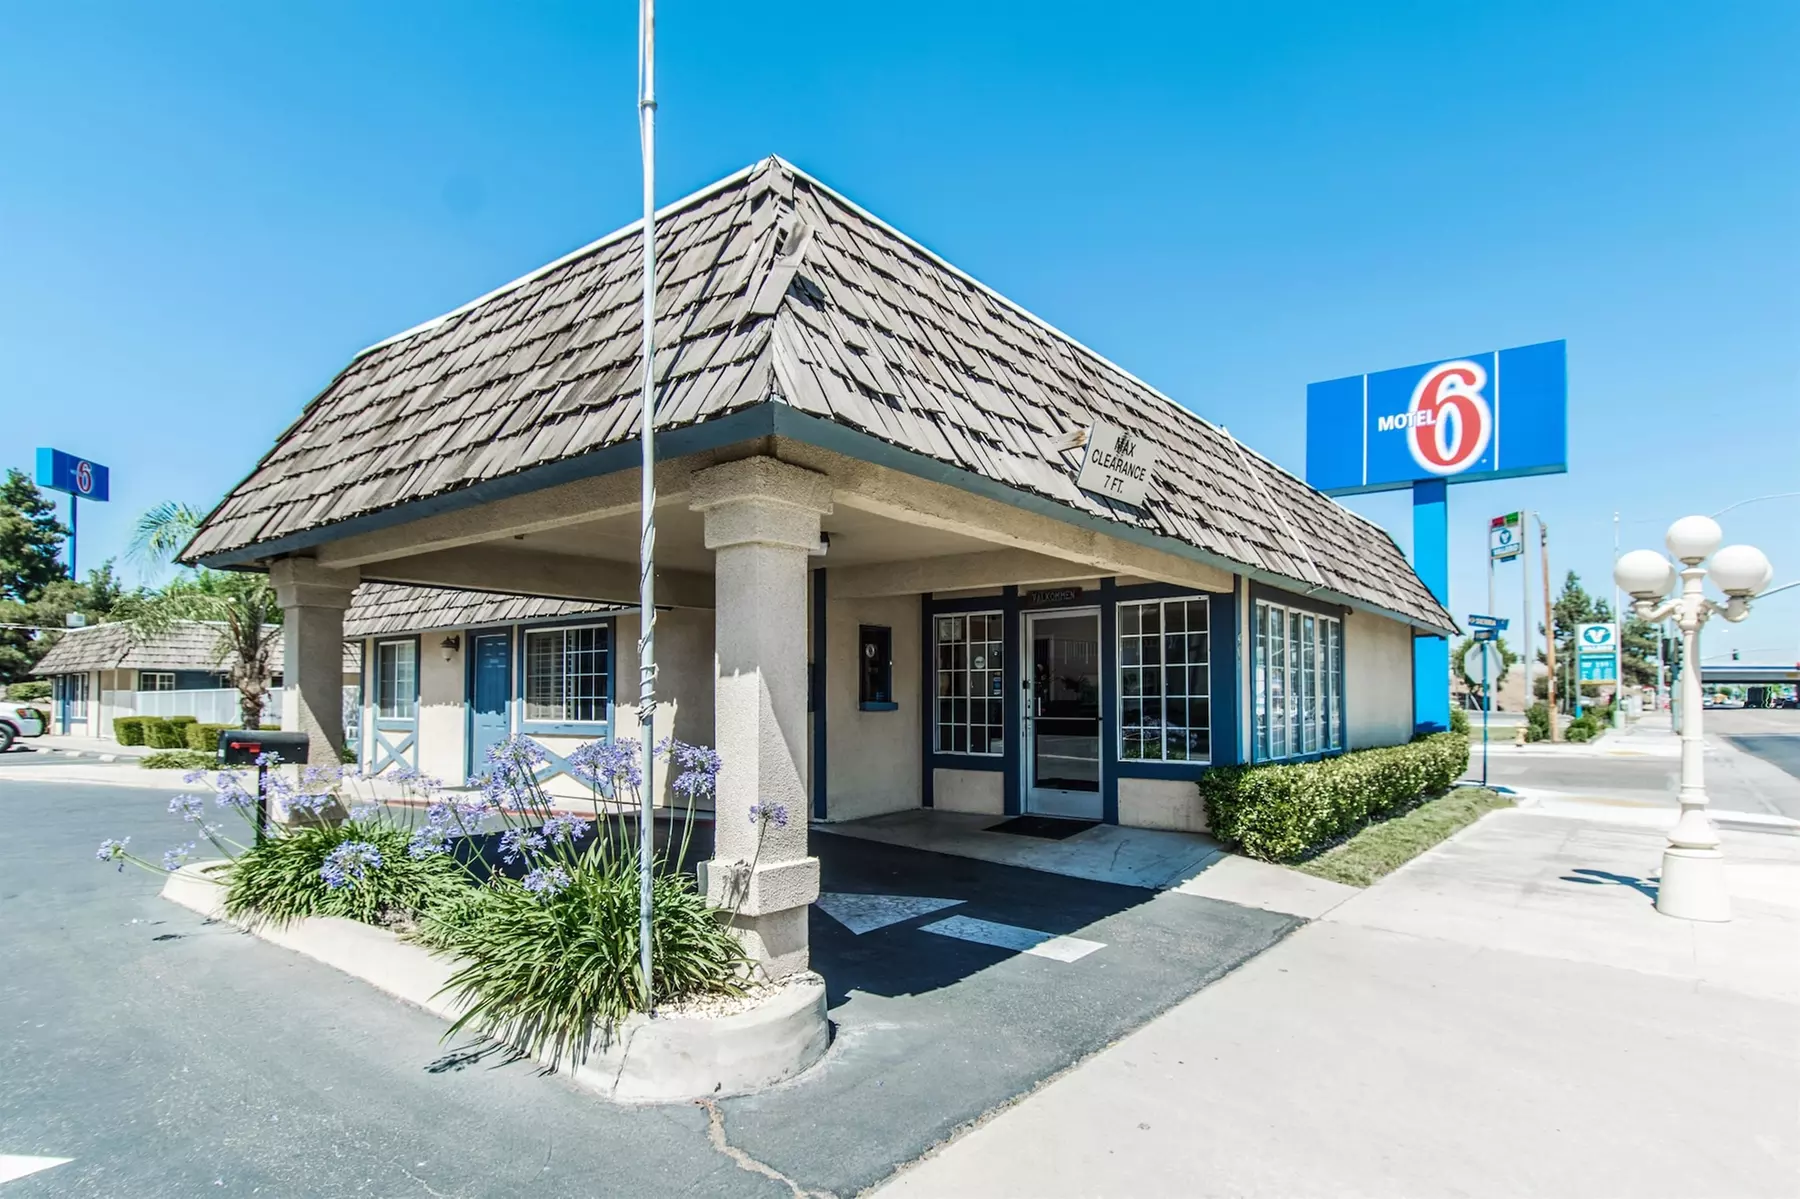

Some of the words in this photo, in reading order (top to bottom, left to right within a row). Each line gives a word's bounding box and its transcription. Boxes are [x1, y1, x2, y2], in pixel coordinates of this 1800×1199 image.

[1378, 409, 1436, 432] MOTEL
[1408, 361, 1490, 473] 6
[1114, 435, 1136, 457] MAX
[77, 461, 92, 493] 6
[1091, 448, 1146, 481] CLEARANCE
[1104, 475, 1111, 488] 7
[1110, 477, 1124, 494] FT.
